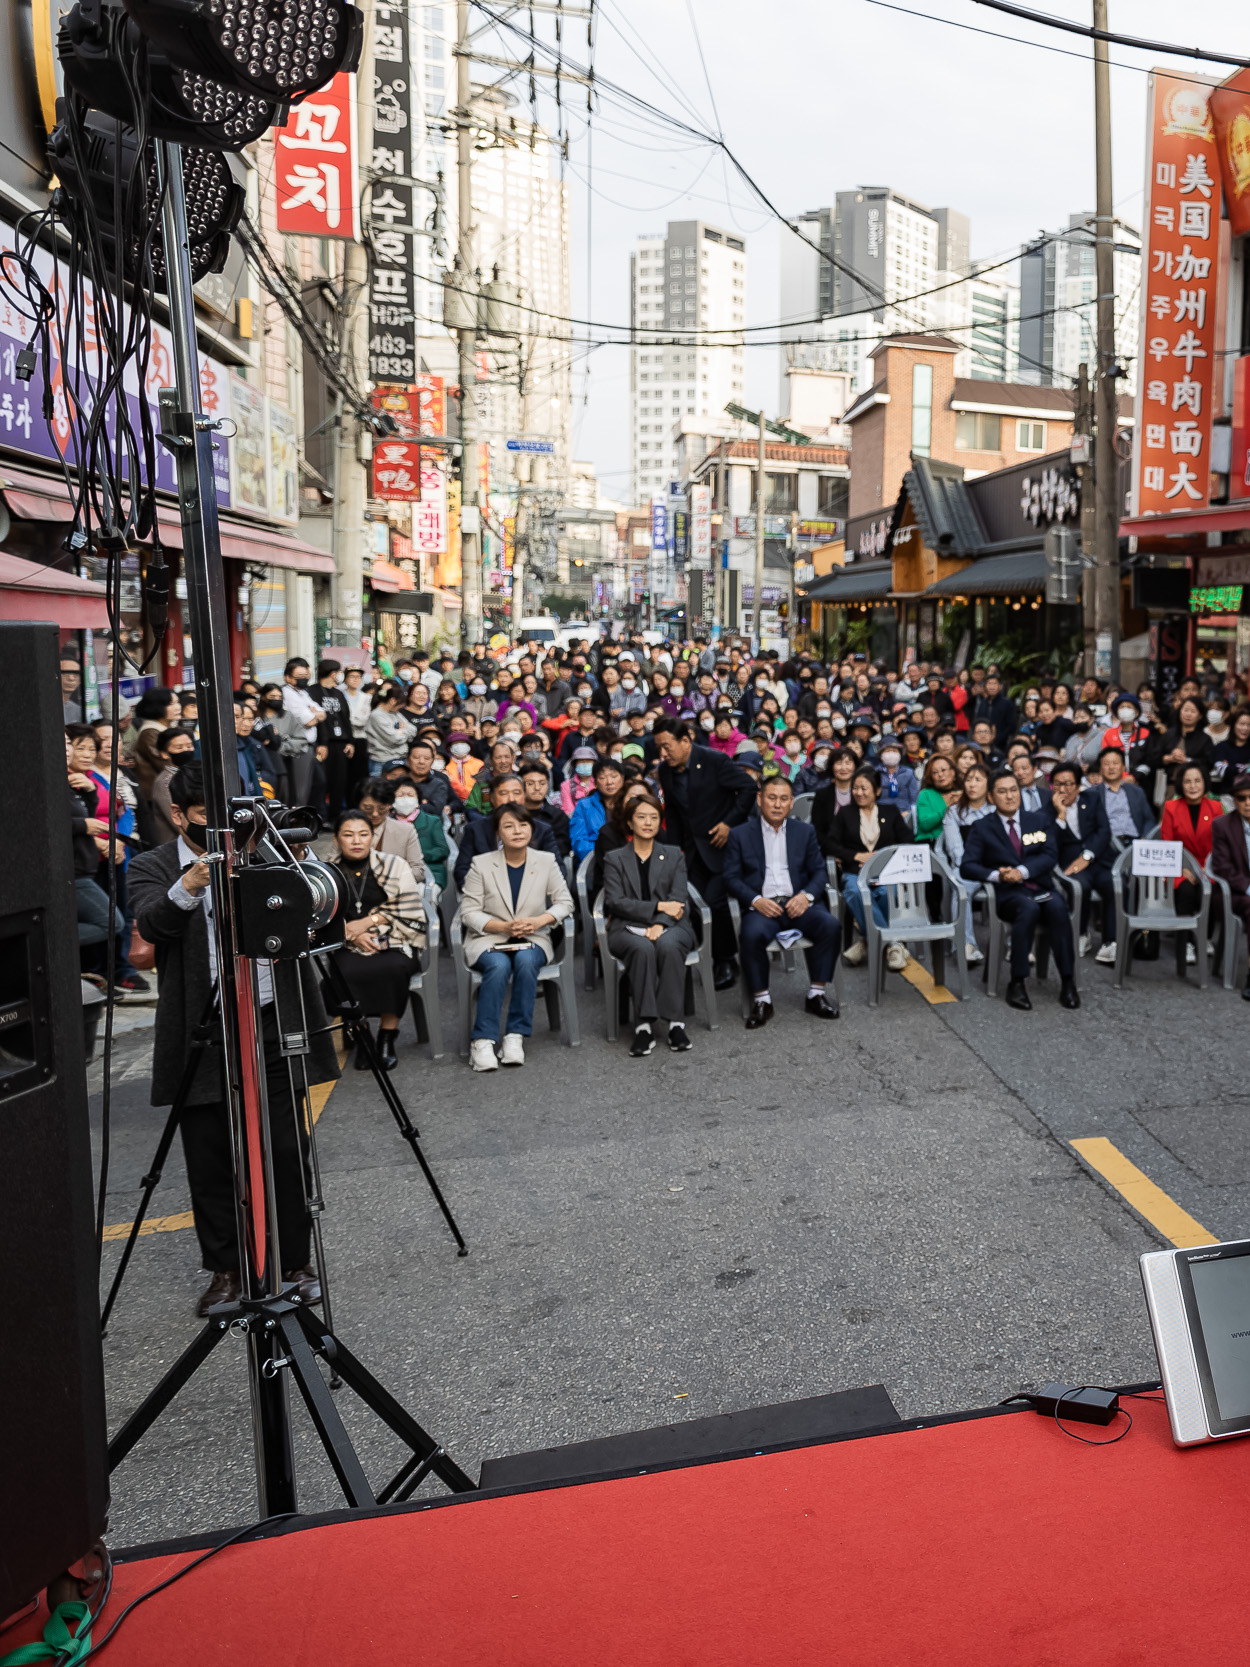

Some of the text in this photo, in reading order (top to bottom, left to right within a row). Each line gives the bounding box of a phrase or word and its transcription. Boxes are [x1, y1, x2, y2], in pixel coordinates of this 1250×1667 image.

[278, 77, 348, 229] 꼬치
[368, 354, 414, 377] 1833
[1142, 162, 1177, 515] 미국가주우육면대
[1164, 152, 1215, 513] 美国加州牛肉面大
[1139, 848, 1176, 860] 내빈석
